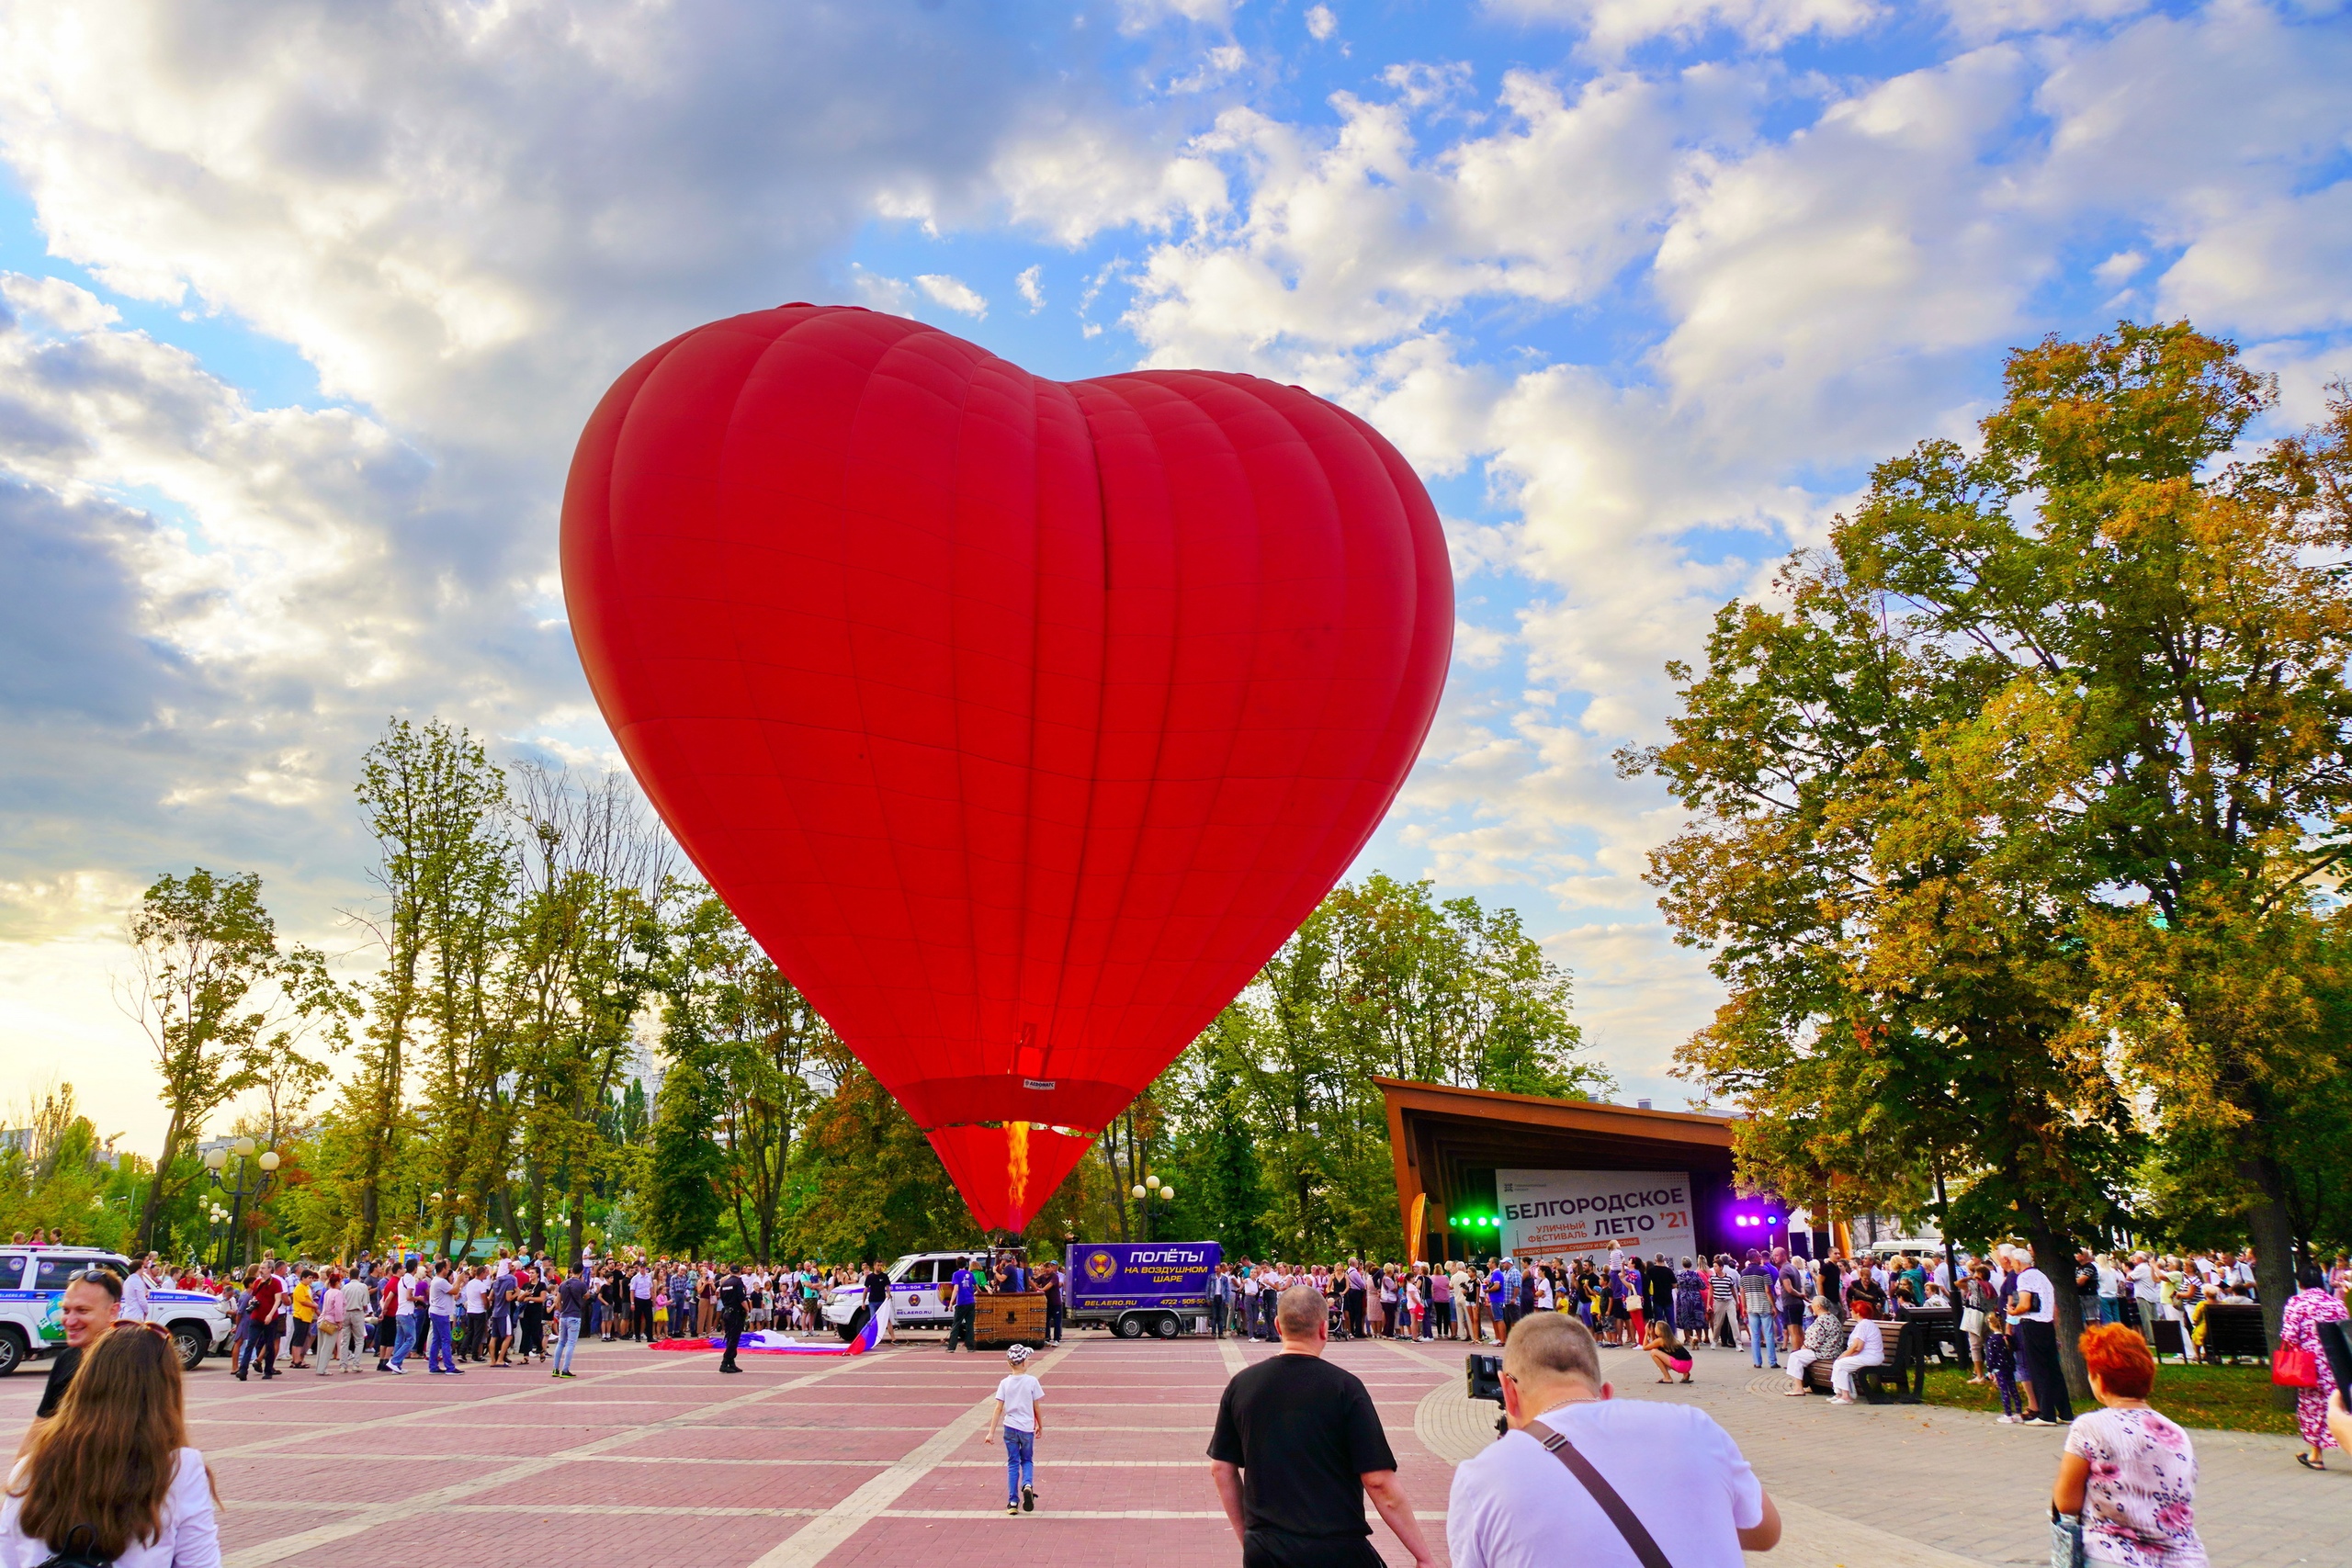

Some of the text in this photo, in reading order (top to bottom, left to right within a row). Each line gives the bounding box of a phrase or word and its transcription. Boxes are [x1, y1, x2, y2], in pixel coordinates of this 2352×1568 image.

[1505, 1188, 1684, 1220] БЕЛГОРОДСКОЕ
[1536, 1221, 1586, 1234] УЛИЧНЫЙ
[1594, 1215, 1655, 1236] ЛЕТО
[1528, 1231, 1588, 1243] ФЕСТИВАЛЬ
[1569, 1243, 1594, 1251] СУББОТУ
[1600, 1239, 1638, 1247] ВОСЕНЬЕ
[1129, 1248, 1204, 1263] ПОЛЁТЫ
[1140, 1266, 1209, 1275] ВОЗДУШНОМ
[1153, 1275, 1183, 1283] ШАРЕ
